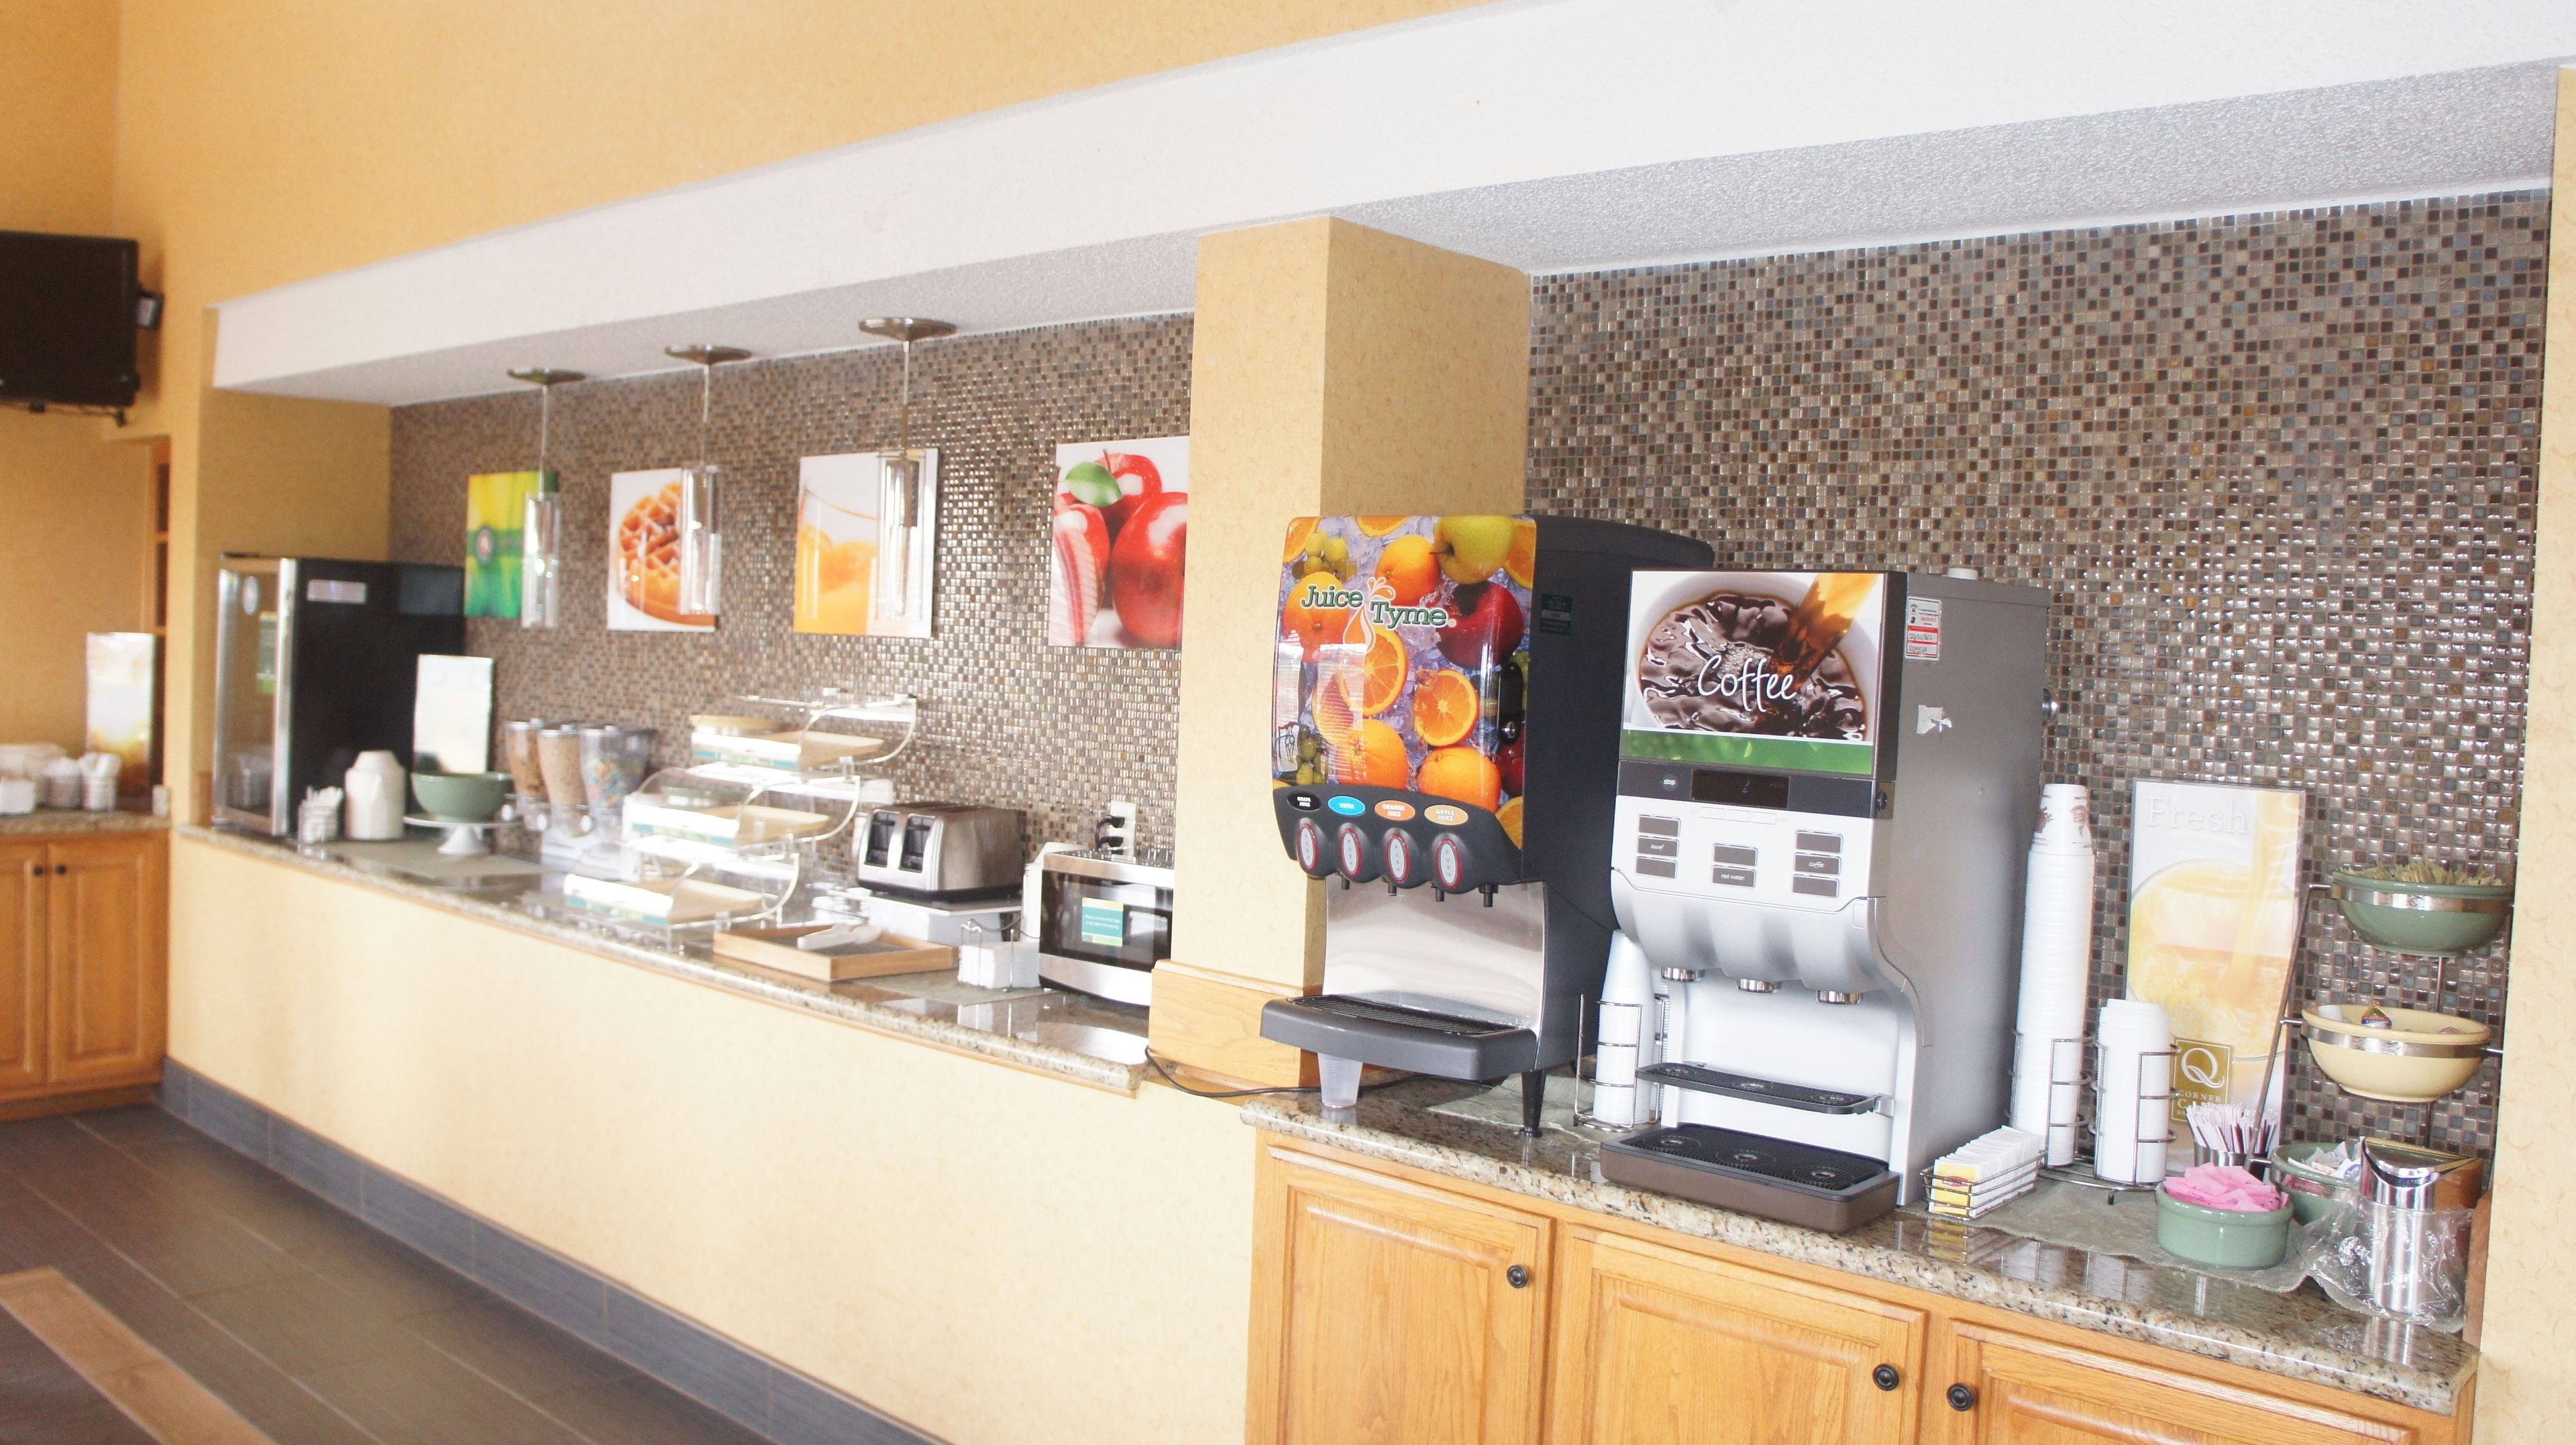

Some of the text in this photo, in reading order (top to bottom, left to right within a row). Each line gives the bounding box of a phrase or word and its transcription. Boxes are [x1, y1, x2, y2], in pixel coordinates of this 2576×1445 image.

[1301, 584, 1448, 629] Juice Tyme
[1697, 654, 1797, 713] Coffee
[1663, 778, 1676, 786] stop
[1382, 803, 1405, 812] ORANGE
[1436, 808, 1455, 816] APPLE
[1438, 814, 1454, 822] JUICE
[2146, 795, 2249, 835] Fresh
[2181, 1047, 2225, 1089] Q
[2178, 1089, 2222, 1102] CORNER
